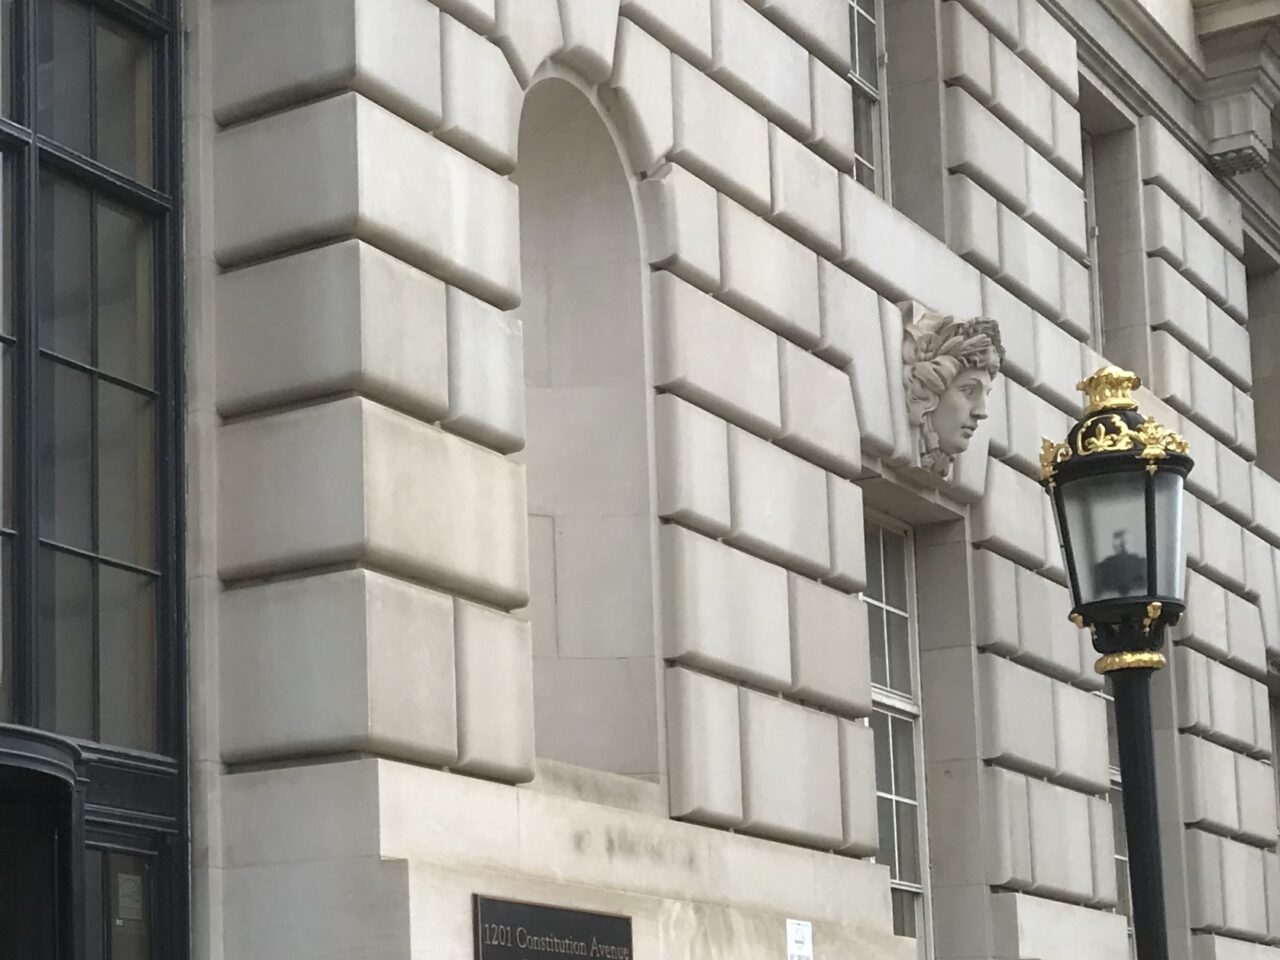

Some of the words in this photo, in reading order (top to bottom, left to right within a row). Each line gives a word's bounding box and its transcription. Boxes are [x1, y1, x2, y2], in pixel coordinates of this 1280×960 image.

[484, 924, 512, 946] 1201
[516, 927, 587, 955] Constitution
[590, 937, 629, 960] Avenue
